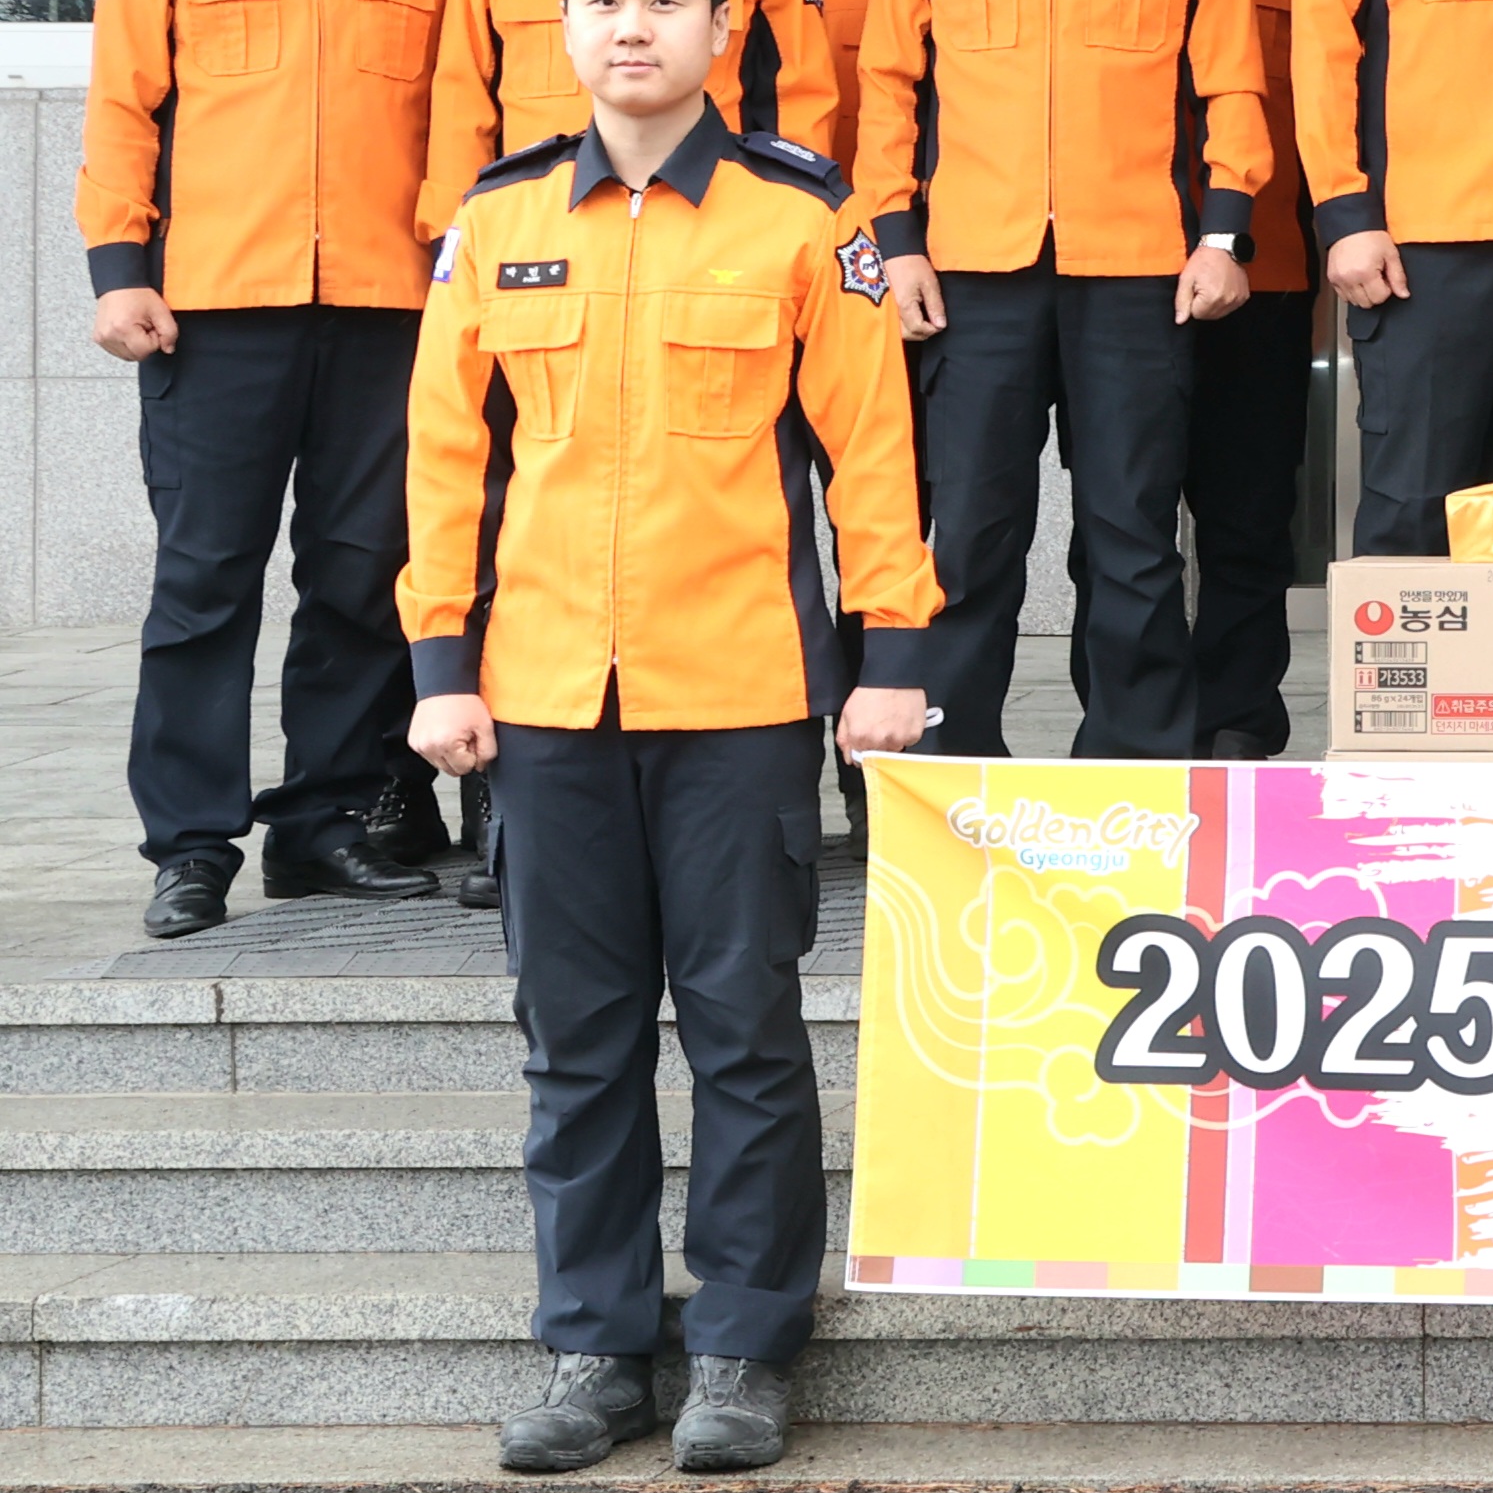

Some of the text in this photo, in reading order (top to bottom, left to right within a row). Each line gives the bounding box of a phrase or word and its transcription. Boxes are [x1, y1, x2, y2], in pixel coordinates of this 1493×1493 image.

[1400, 591, 1469, 603] 인생을 맛있게
[1399, 605, 1468, 633] 농심
[1379, 669, 1425, 687] 가3533
[1435, 720, 1467, 733] 던지지
[948, 797, 1197, 862] Golden City
[1019, 848, 1125, 871] Gyeongju
